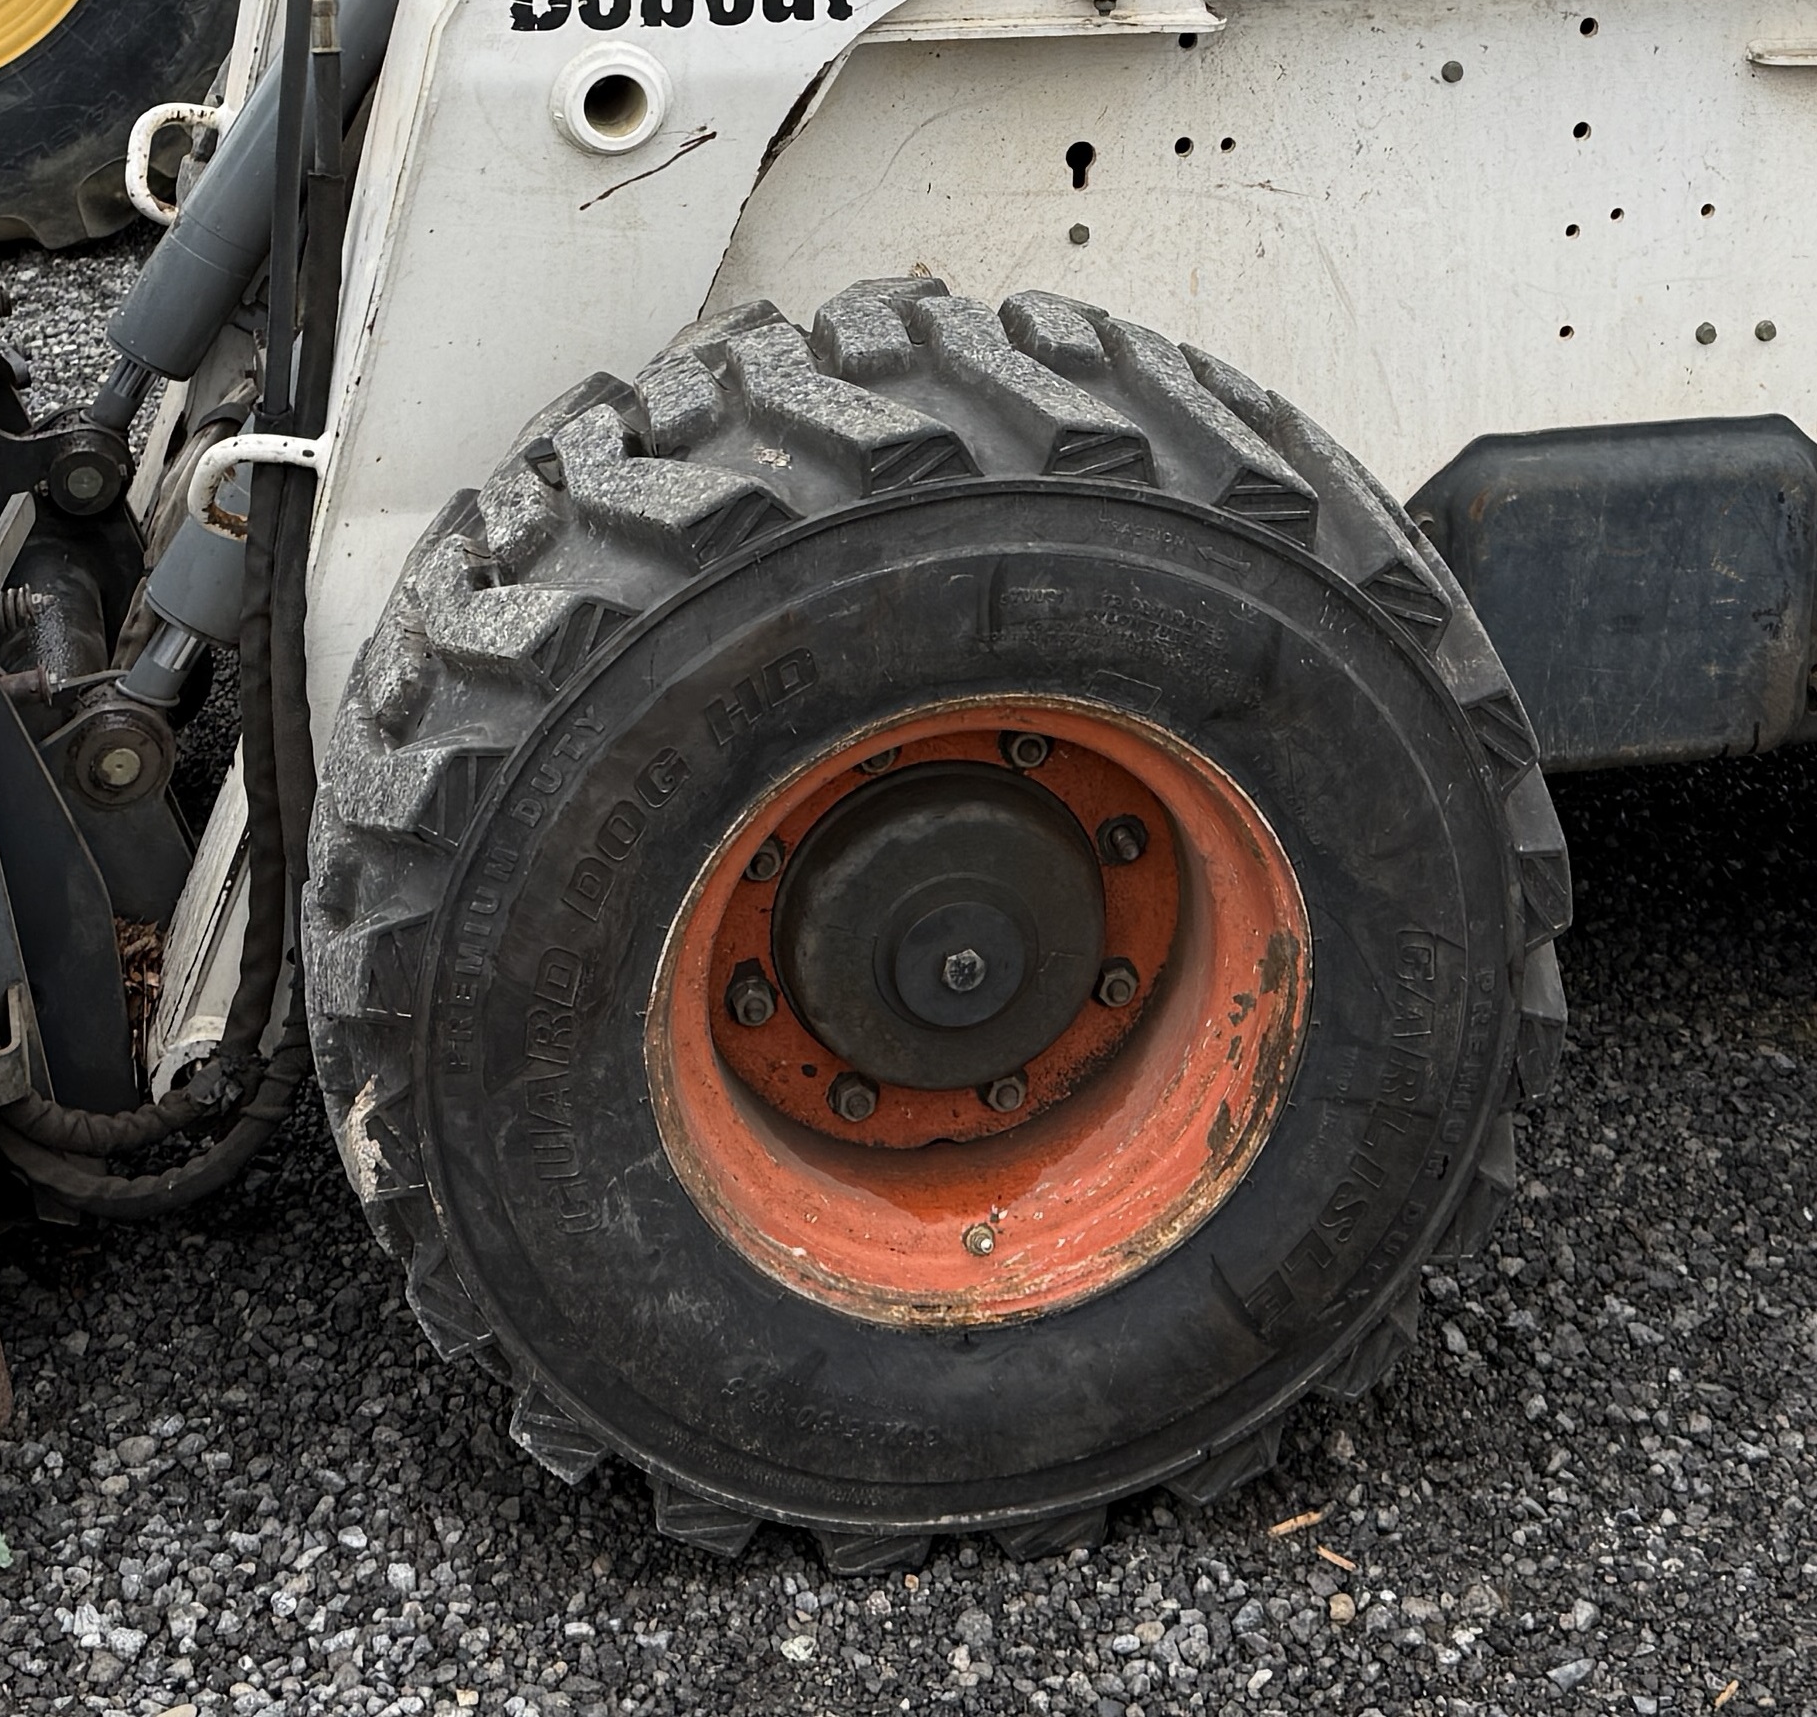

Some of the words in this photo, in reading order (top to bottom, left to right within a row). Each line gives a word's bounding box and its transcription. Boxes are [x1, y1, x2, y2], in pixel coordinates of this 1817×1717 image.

[704, 647, 820, 747] HD
[445, 844, 520, 1075] PREMIUM
[511, 706, 607, 828] DUTY
[562, 746, 692, 922] DOG
[526, 946, 610, 1235] GUARD
